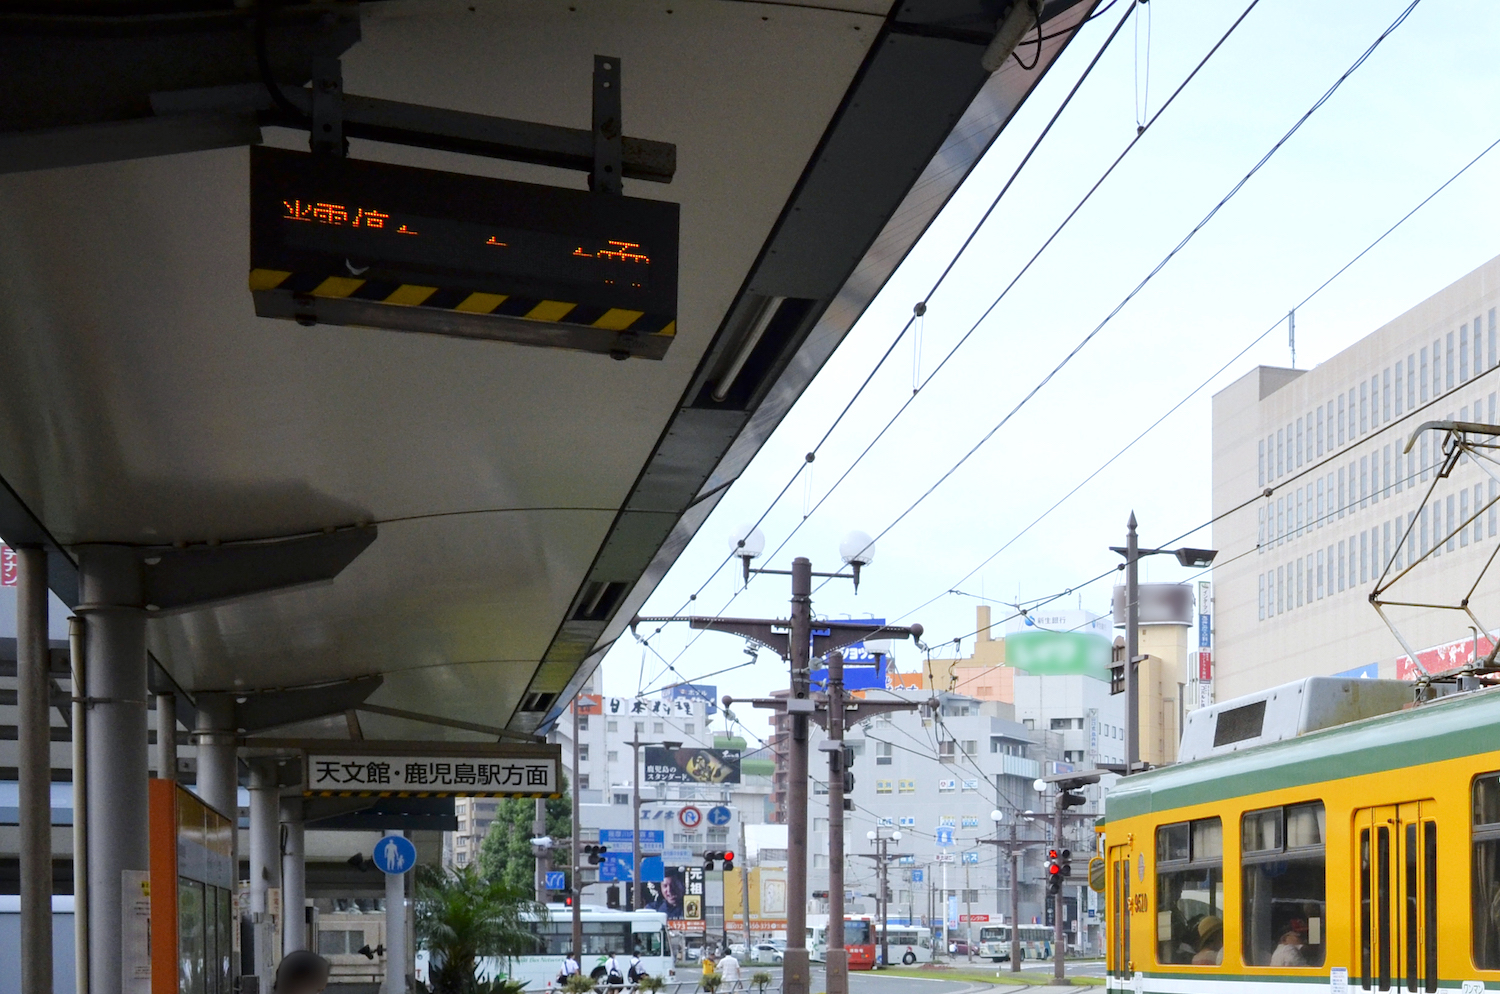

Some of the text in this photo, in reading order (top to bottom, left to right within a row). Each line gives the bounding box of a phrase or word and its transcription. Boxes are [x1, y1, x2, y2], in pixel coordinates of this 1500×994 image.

[610, 697, 694, 717] 日本料理
[315, 761, 549, 787] 天文館・鹿児島駅方面
[646, 765, 677, 773] 鹿児島の
[690, 867, 703, 895] 元祖
[1463, 984, 1484, 994] ワンマン
